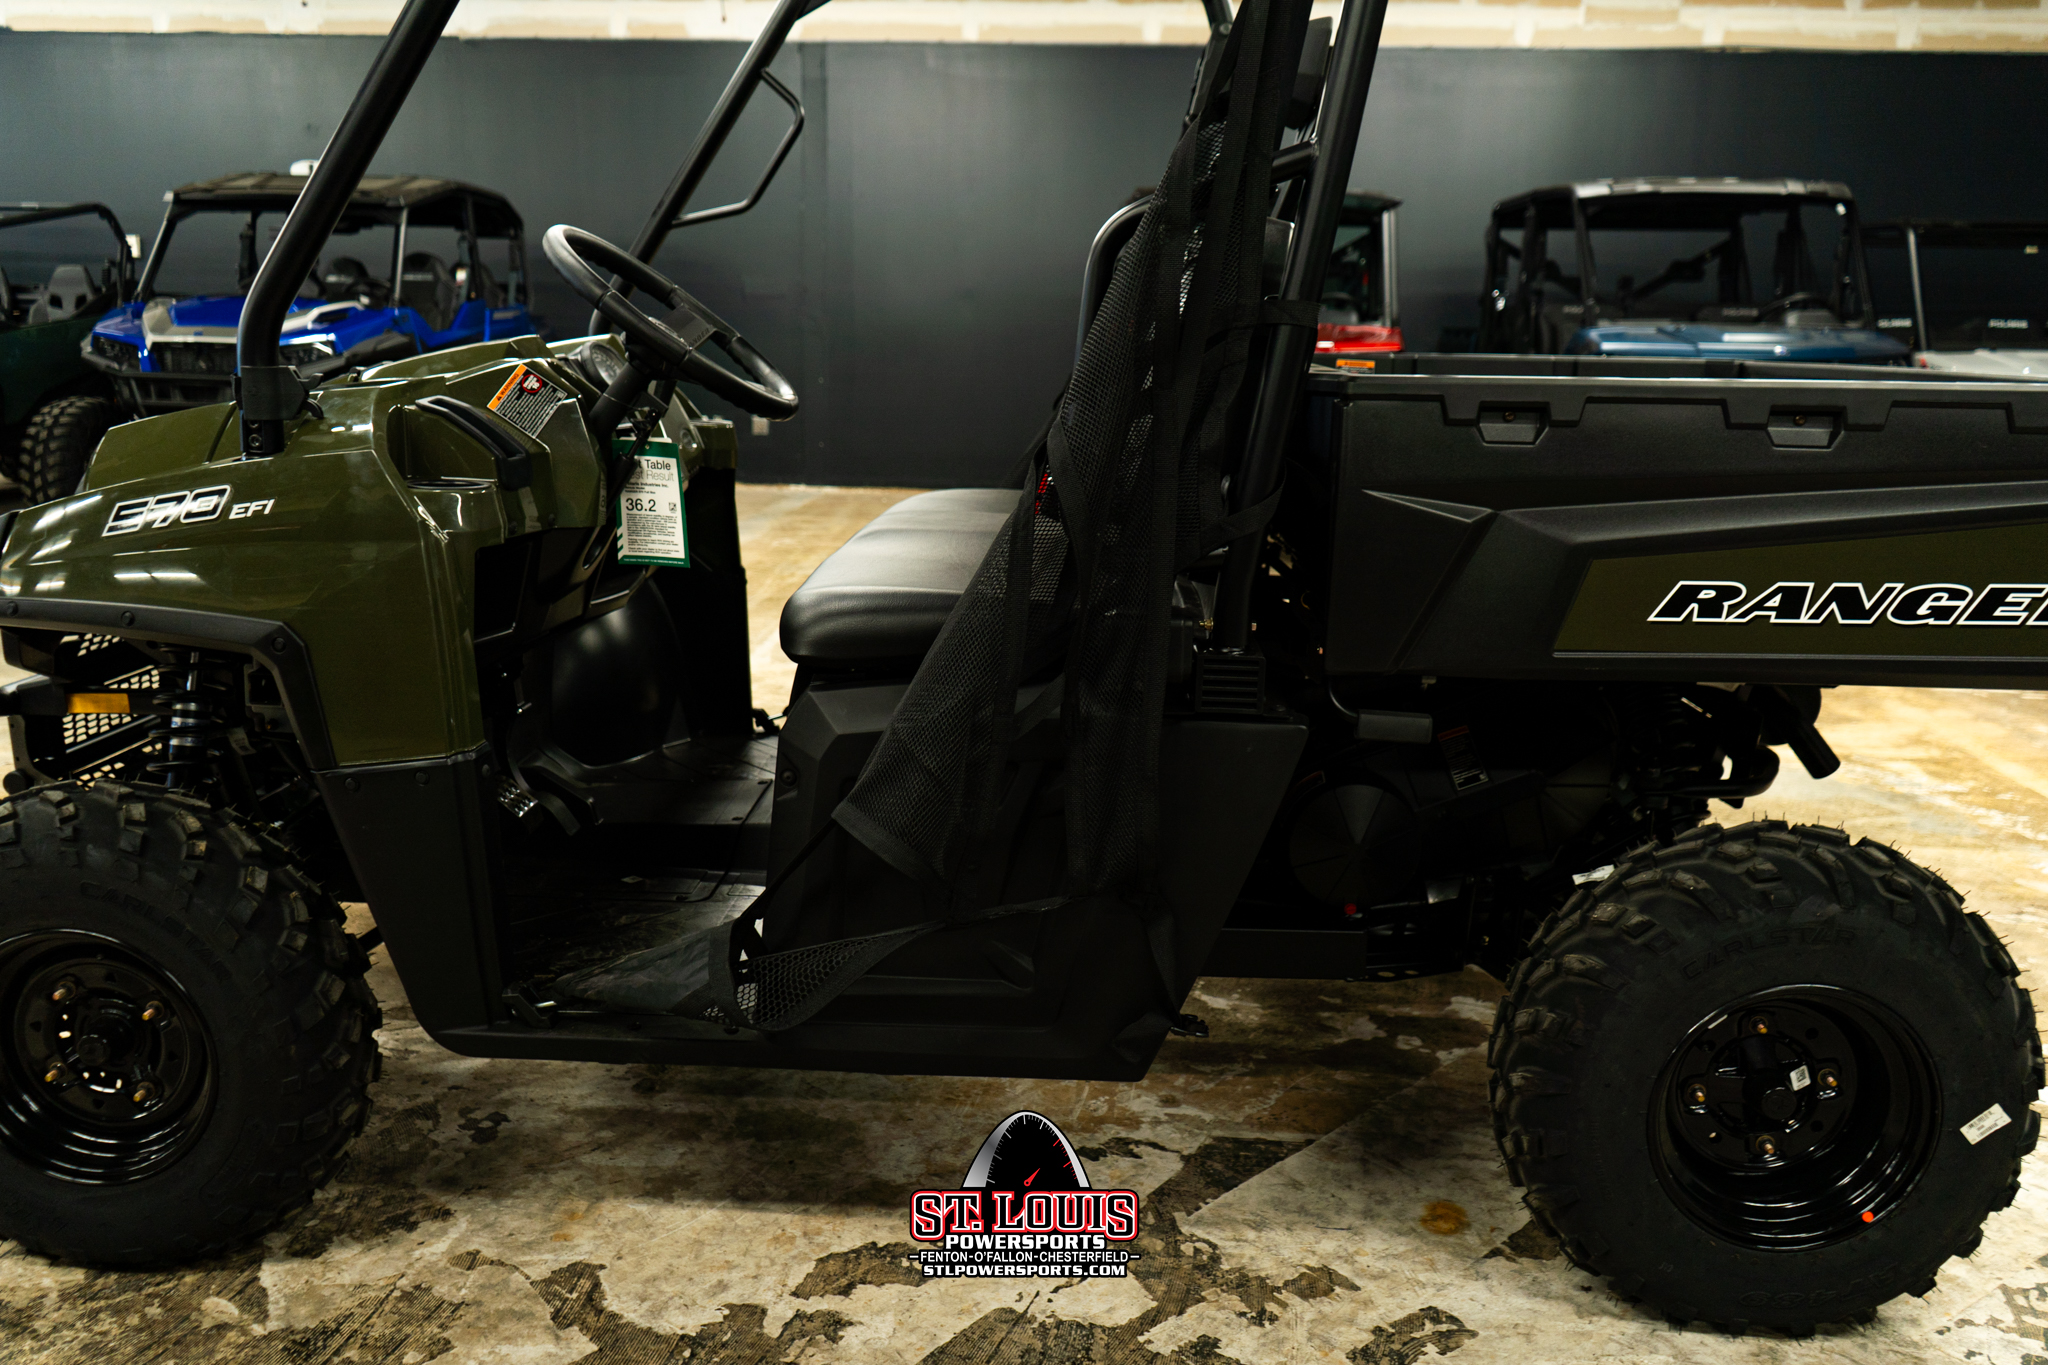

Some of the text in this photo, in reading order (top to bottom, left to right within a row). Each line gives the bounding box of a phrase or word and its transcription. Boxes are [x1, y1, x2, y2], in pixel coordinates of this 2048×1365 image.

[500, 373, 519, 396] WARNING
[644, 459, 671, 470] Table
[646, 469, 675, 482] Result
[101, 484, 276, 537] 570 EFI
[625, 498, 657, 512] 36.2
